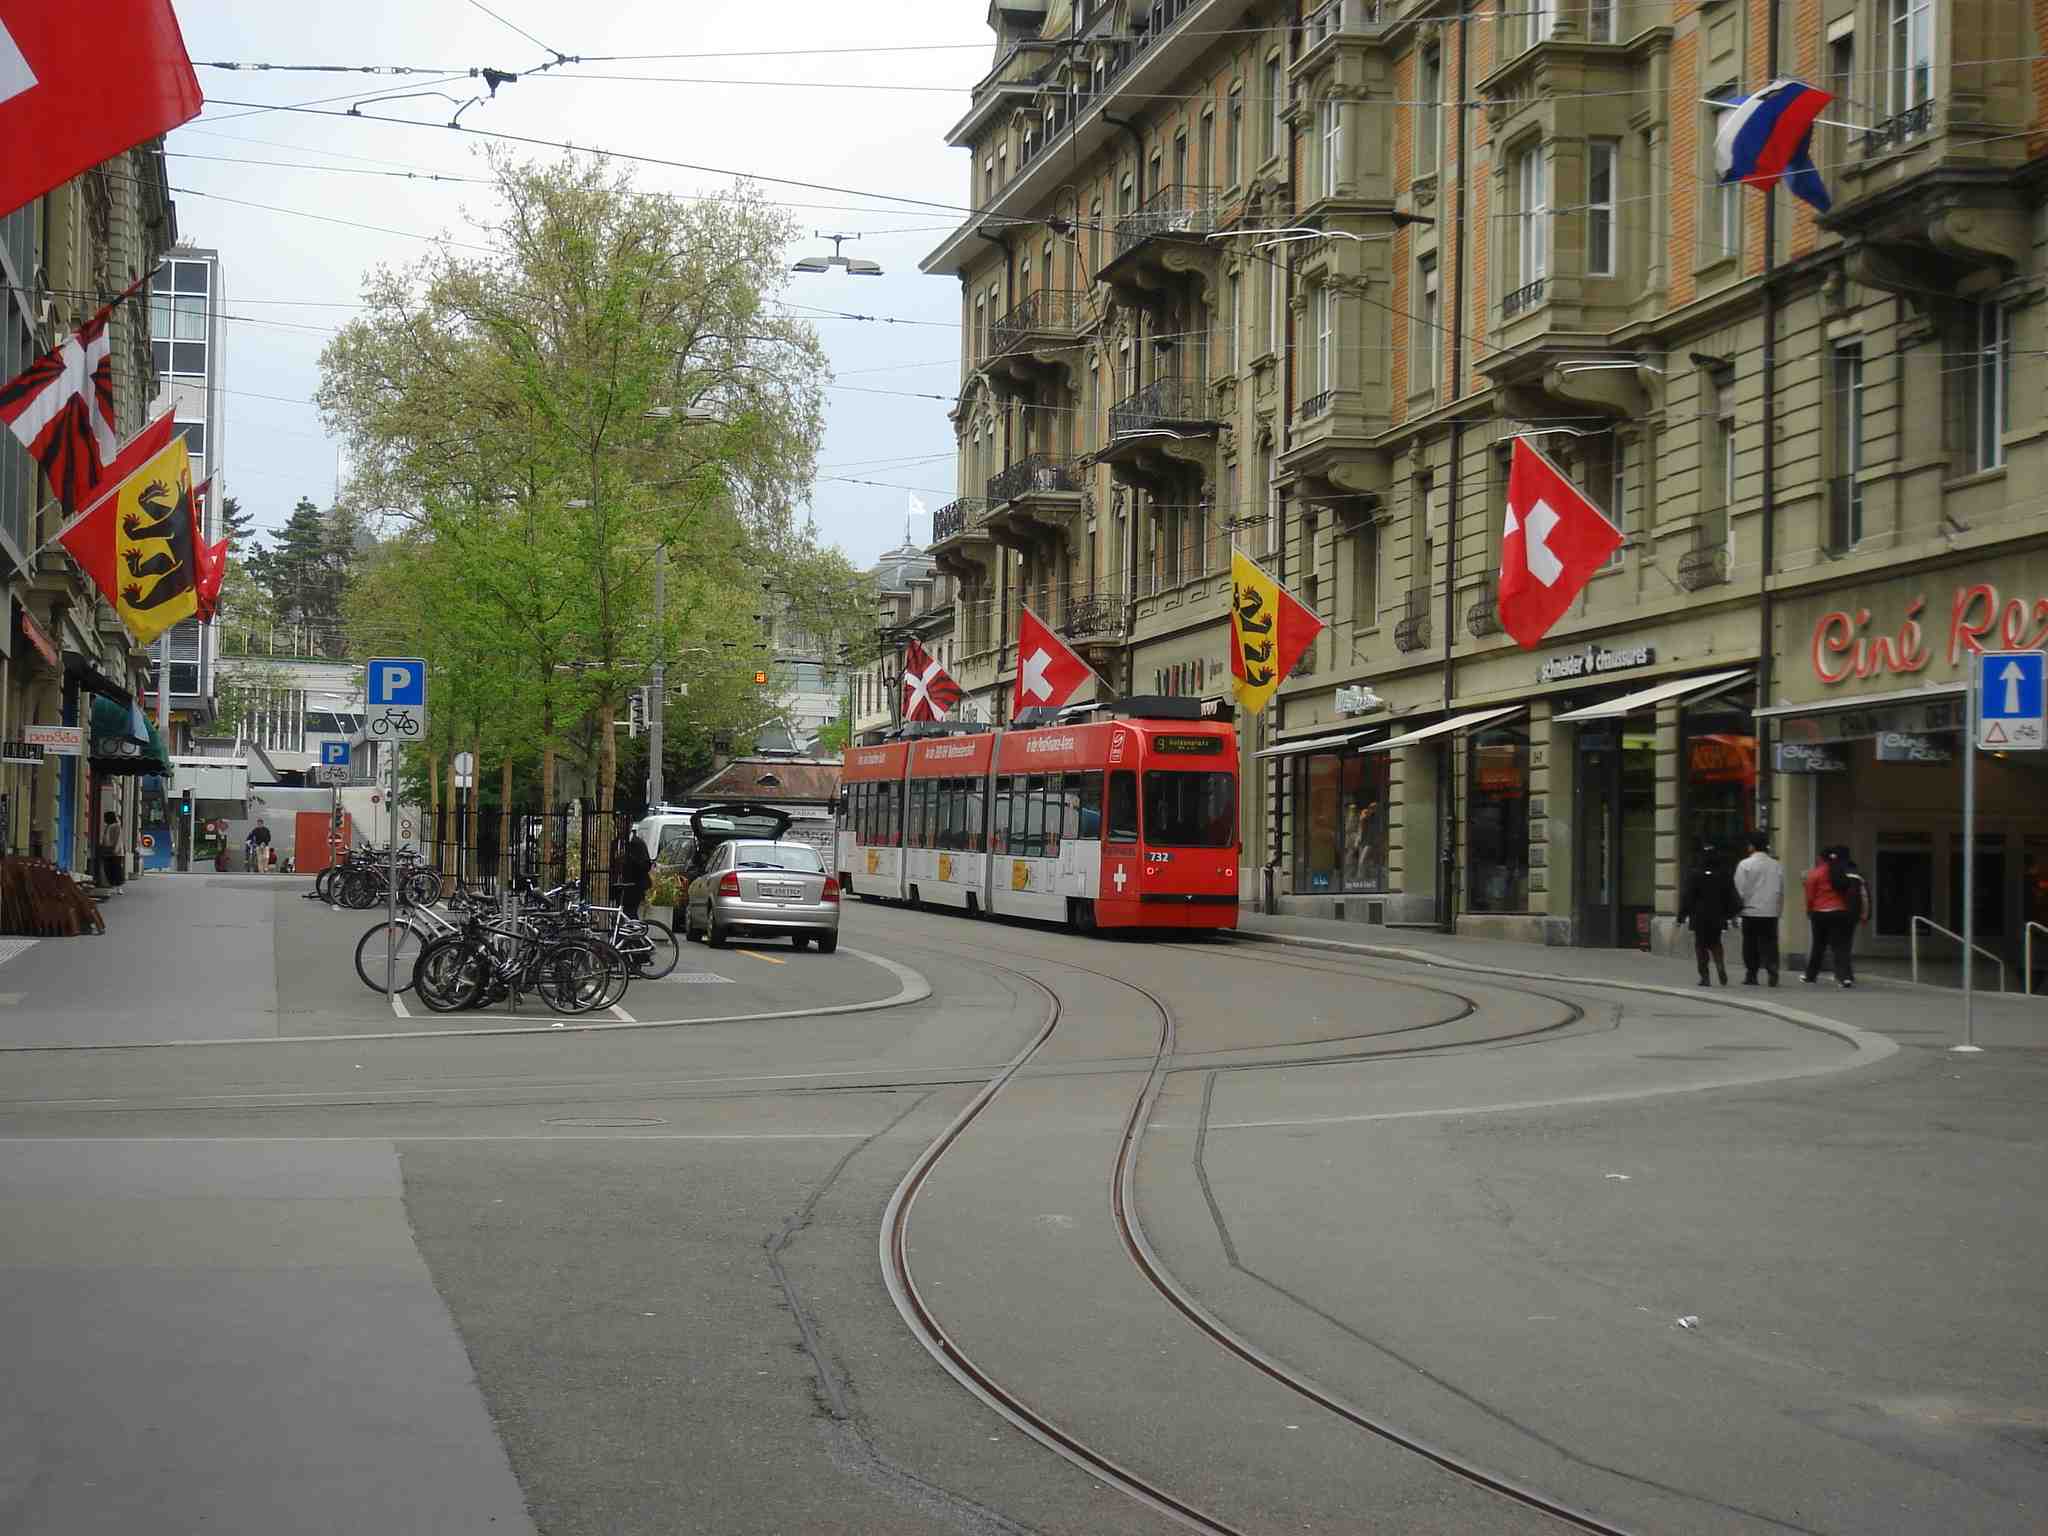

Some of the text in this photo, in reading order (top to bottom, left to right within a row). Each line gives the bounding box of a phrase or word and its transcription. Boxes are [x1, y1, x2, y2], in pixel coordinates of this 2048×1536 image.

[1811, 593, 1931, 683] Ciné
[382, 667, 411, 701] P
[328, 745, 344, 763] P
[1149, 852, 1169, 862] 732
